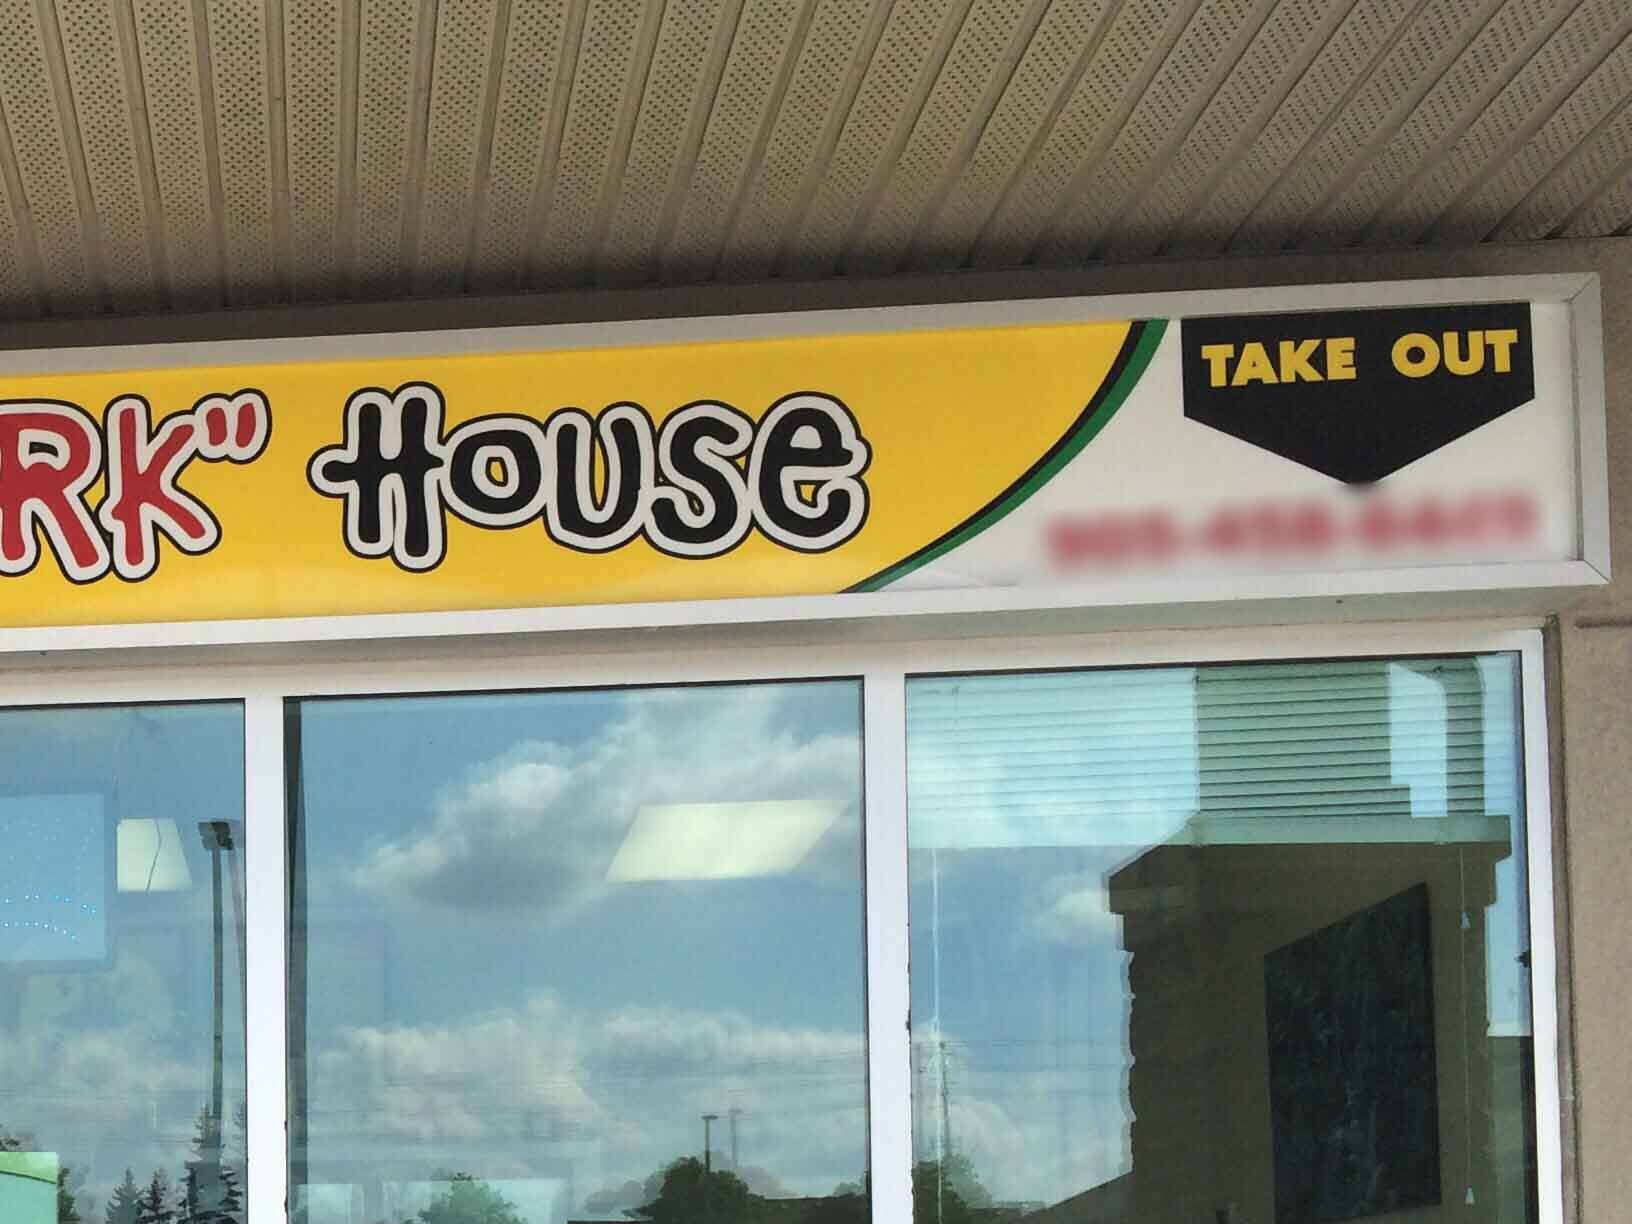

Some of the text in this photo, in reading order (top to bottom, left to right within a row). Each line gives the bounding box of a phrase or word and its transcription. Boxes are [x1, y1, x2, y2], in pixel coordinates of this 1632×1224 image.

[1201, 329, 1518, 388] TAKE OUT
[307, 381, 873, 574] House
